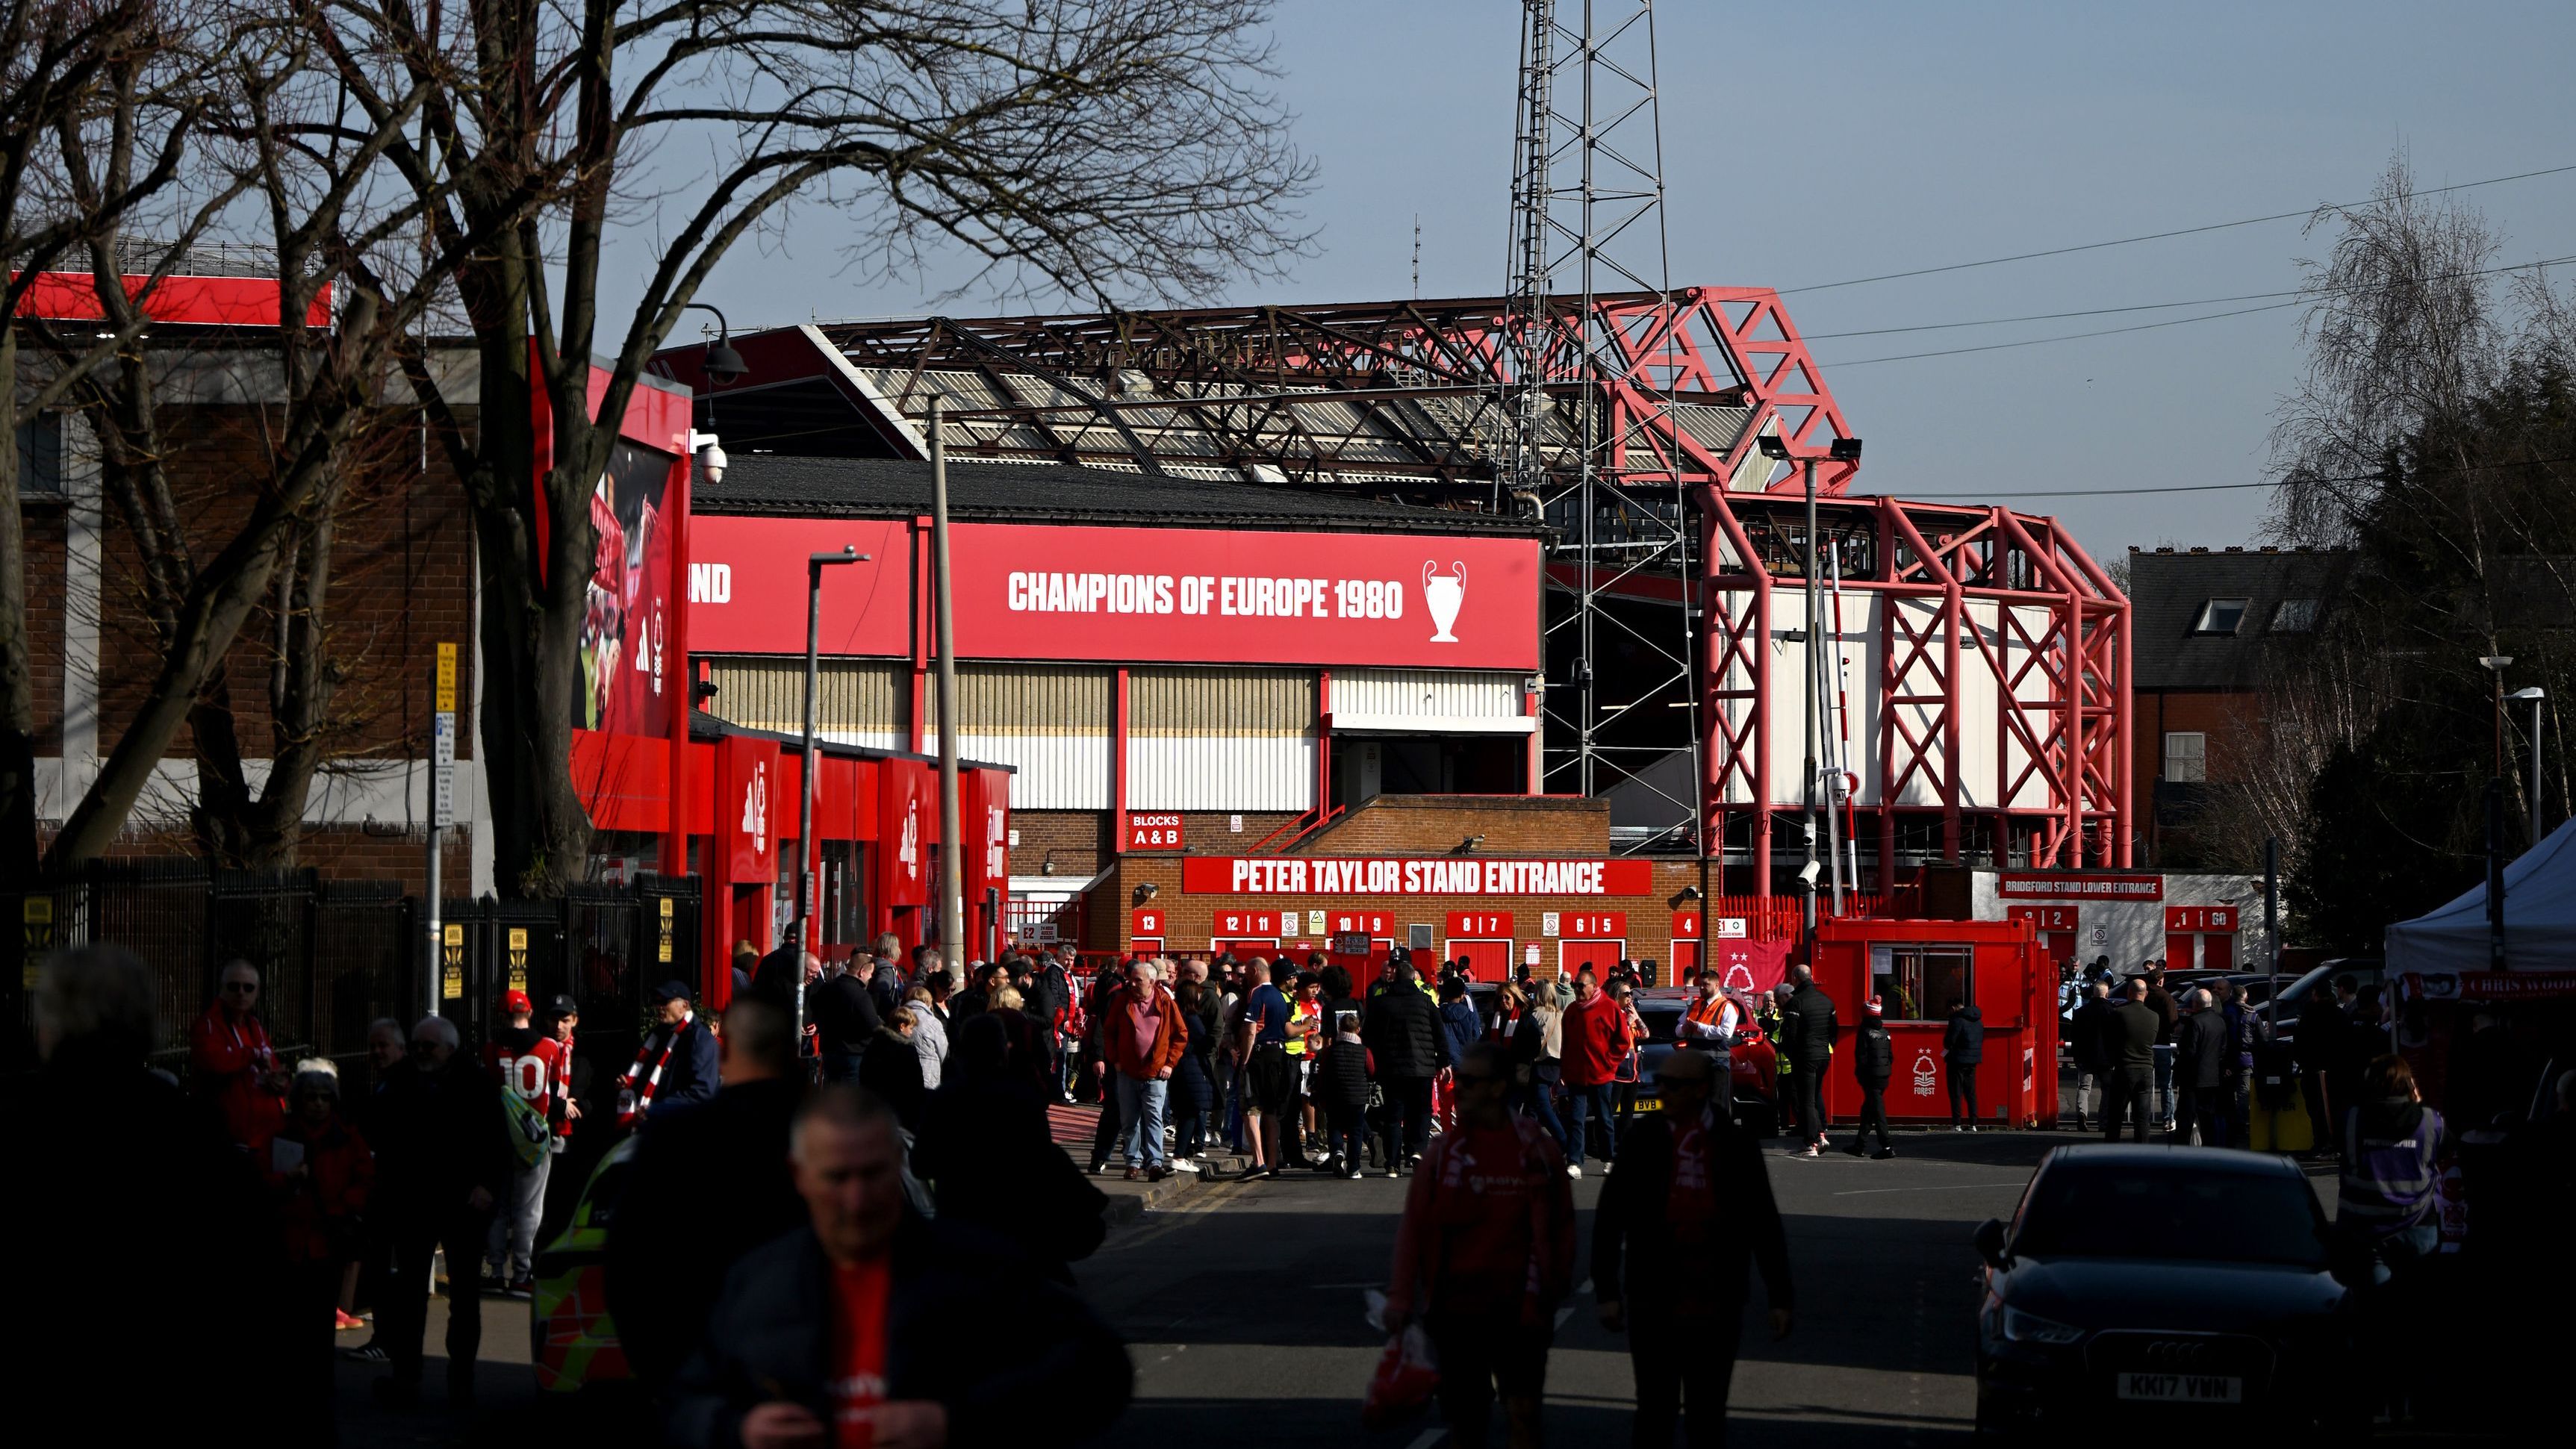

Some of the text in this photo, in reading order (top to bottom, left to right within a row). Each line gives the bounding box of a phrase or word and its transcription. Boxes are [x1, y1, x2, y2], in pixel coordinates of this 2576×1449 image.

[688, 563, 730, 603] ND
[1008, 572, 1402, 619] CHAMPIONS OF EUROPE 1980
[1133, 816, 1179, 826] BLOCKS
[1135, 830, 1177, 844] A & B
[1233, 860, 1605, 894] PETER TAYLOR STAND ENTRANCE
[2006, 881, 2157, 894] BRIDGFORD STAND LOWER ENTRANCE
[1143, 916, 1155, 930] 13
[1226, 916, 1239, 930] 12
[1258, 917, 1269, 931] 11
[1339, 917, 1351, 931] 10
[1373, 917, 1381, 931] 9
[1463, 917, 1471, 931] 8
[1490, 918, 1497, 932] 7
[1576, 918, 1584, 932] 6
[1603, 919, 1611, 932] 5
[1684, 918, 1692, 932] 4
[2053, 912, 2062, 925] 2
[2181, 912, 2186, 925] 1
[2212, 912, 2226, 926] 60
[1023, 927, 1035, 939] E2
[2469, 979, 2576, 991] CHRIS WOOD
[499, 1055, 545, 1100] 10
[1638, 1100, 1656, 1109] BVB
[2129, 1377, 2228, 1399] KK17 VWN
